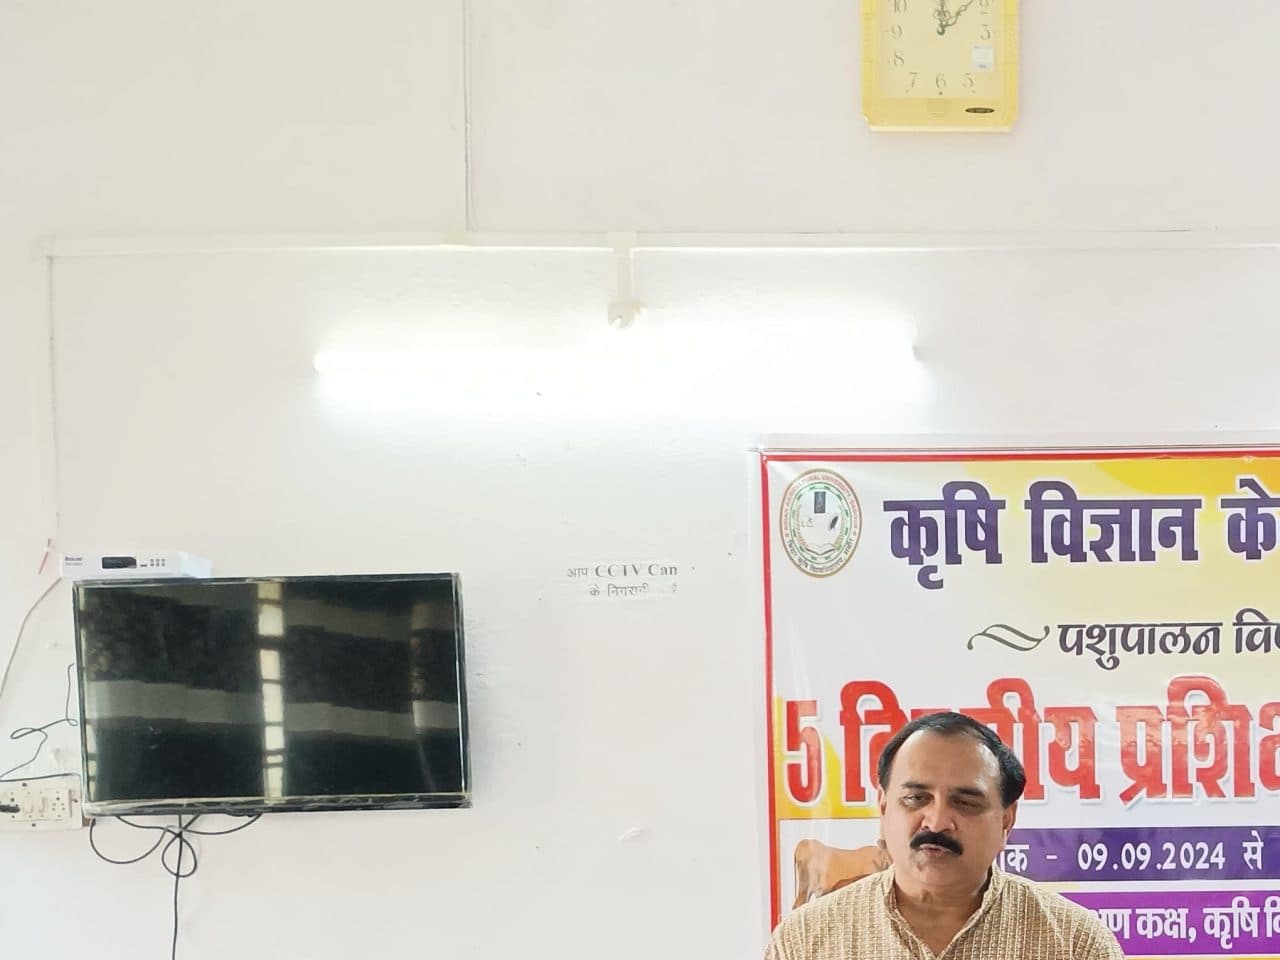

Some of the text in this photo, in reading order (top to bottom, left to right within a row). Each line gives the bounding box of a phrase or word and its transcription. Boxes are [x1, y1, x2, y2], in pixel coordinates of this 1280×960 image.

[883, 481, 1006, 589] कृषि
[1024, 481, 1202, 563] विज्ञान
[1058, 623, 1223, 670] पशुपालन
[787, 700, 822, 802] 5
[1077, 842, 1226, 871] 09.09.2024
[1242, 830, 1264, 870] से
[1202, 896, 1261, 949] कृषि
